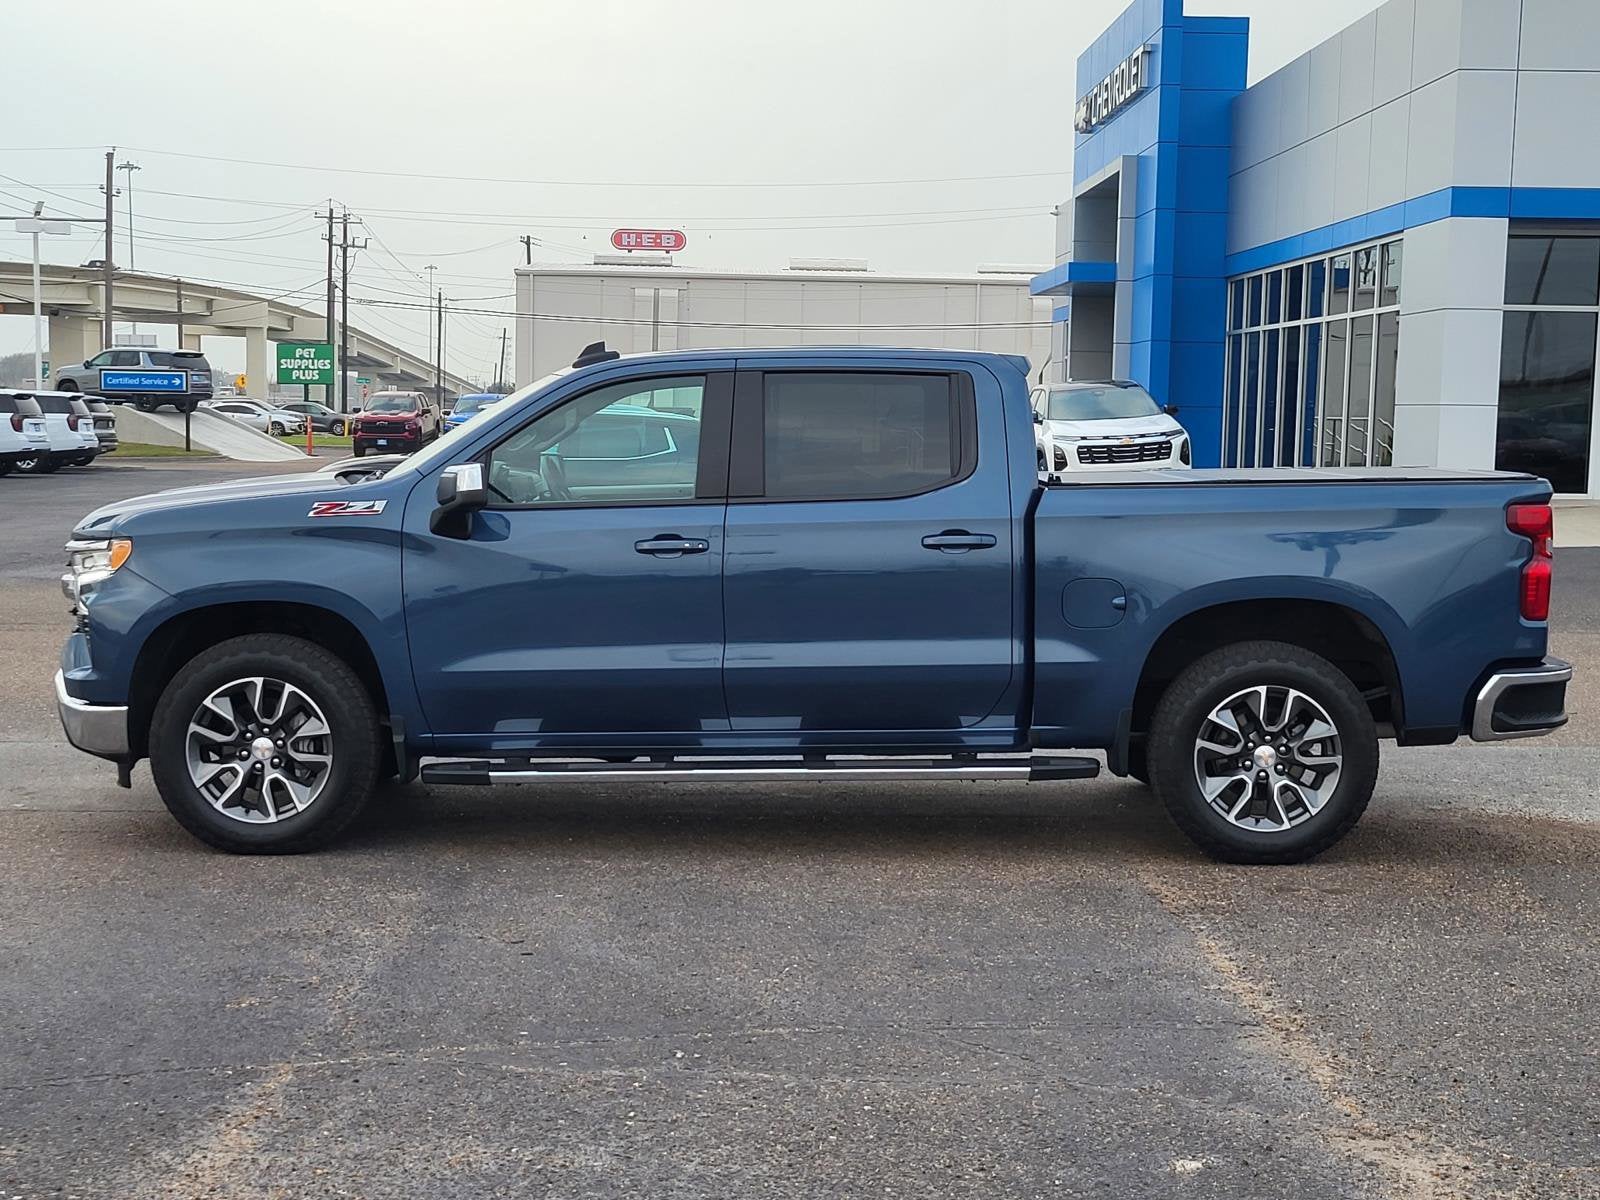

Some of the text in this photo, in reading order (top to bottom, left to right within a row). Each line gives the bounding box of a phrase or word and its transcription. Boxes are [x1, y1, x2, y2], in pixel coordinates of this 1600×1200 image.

[1091, 44, 1144, 126] CHEVROLET
[295, 348, 316, 358] PET
[280, 359, 331, 369] SUPPLIES
[292, 370, 320, 380] PLUS
[106, 376, 169, 386] Certified Service
[307, 499, 388, 517] Z71
